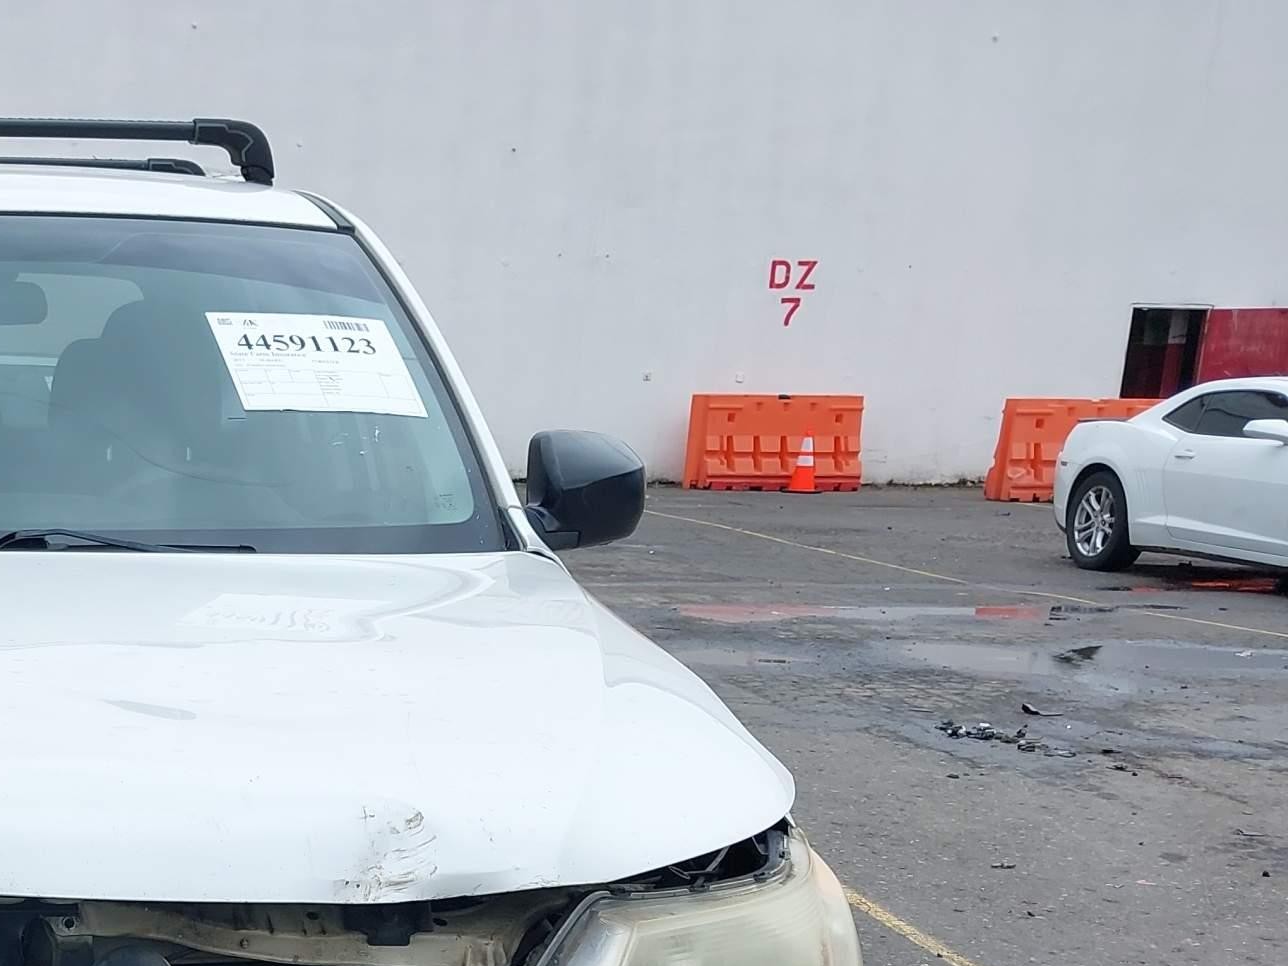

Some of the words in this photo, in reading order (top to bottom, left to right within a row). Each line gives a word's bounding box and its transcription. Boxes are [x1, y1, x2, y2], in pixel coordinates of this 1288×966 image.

[769, 259, 818, 290] DZ
[780, 297, 801, 327] 7
[237, 333, 376, 355] 44591123
